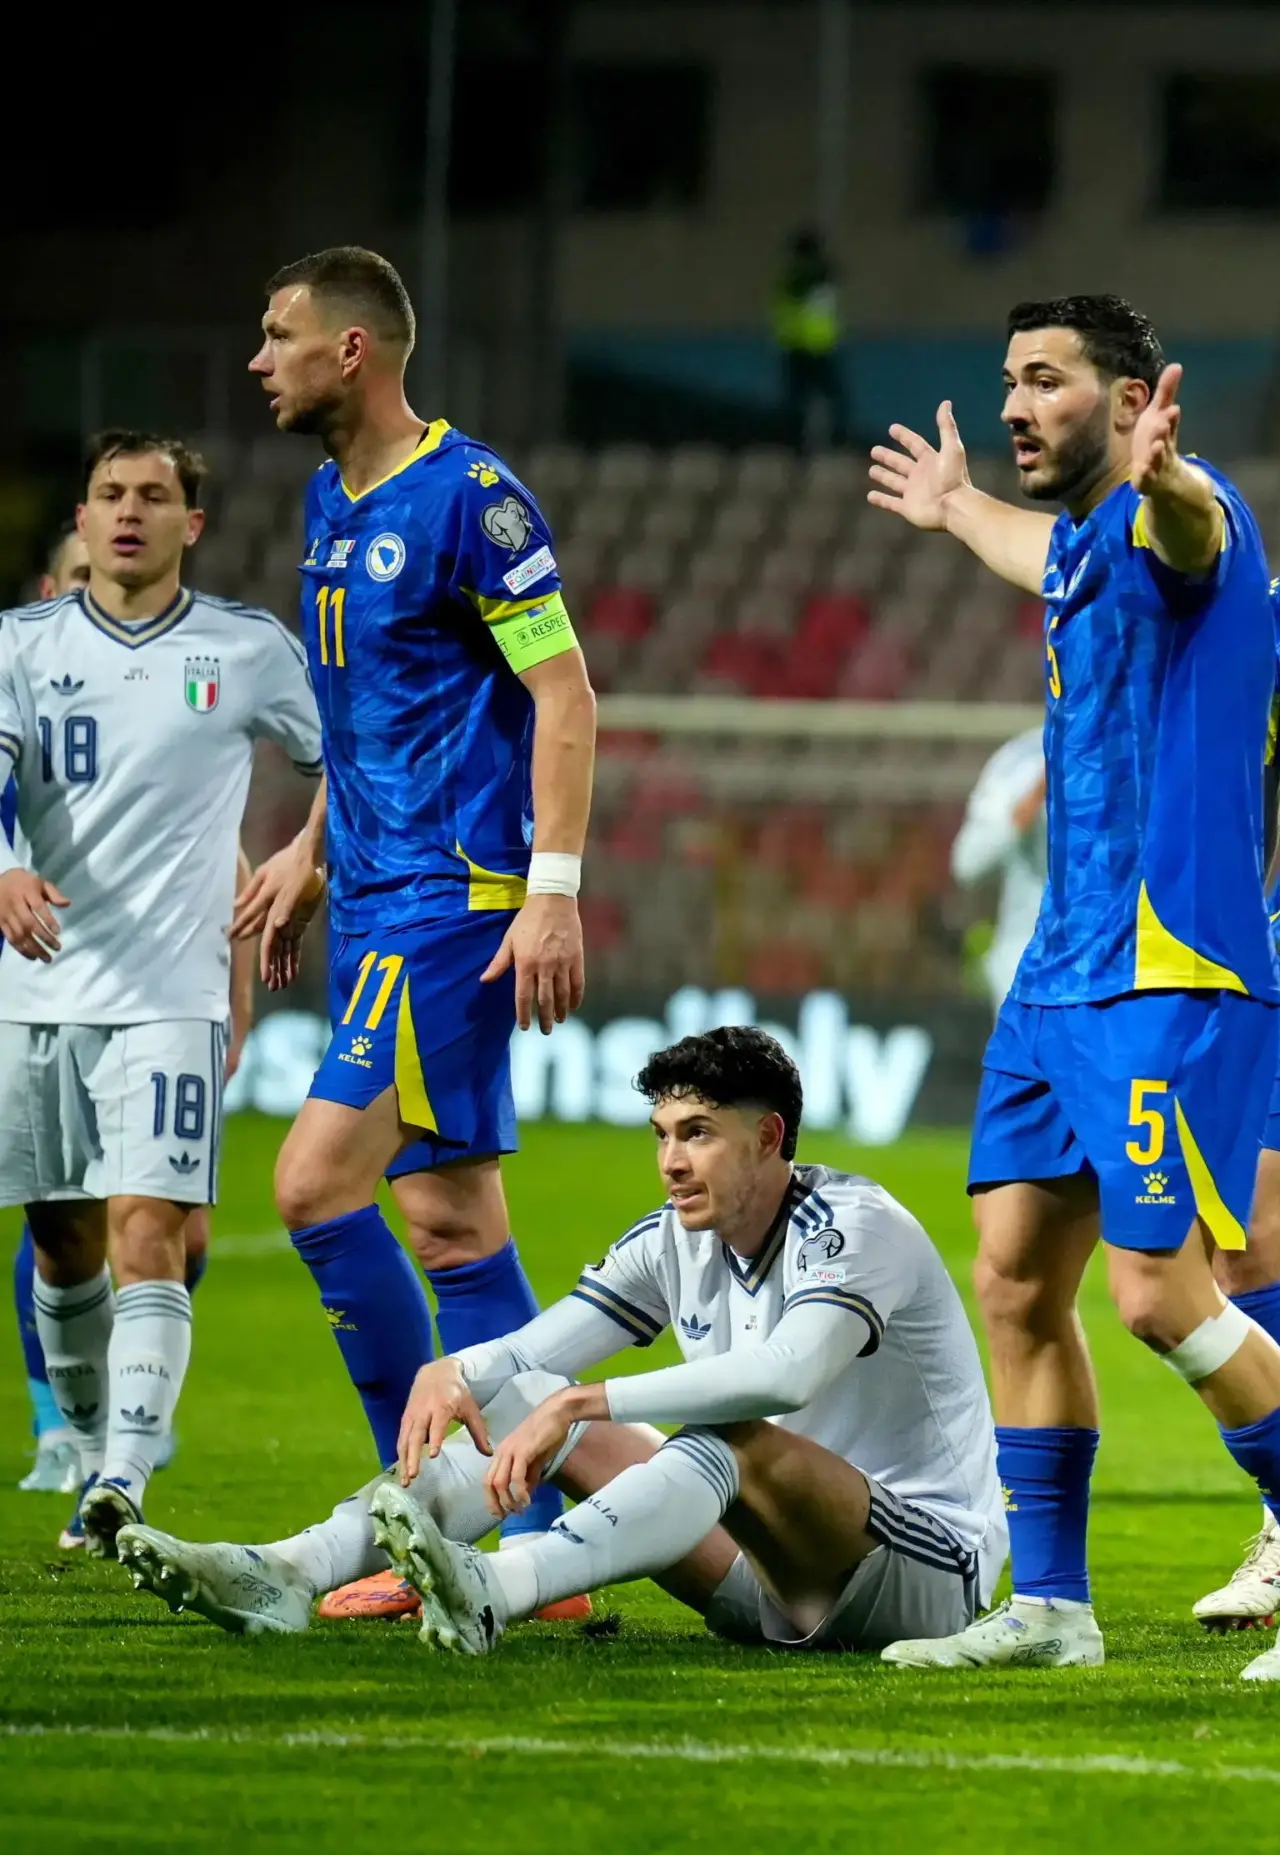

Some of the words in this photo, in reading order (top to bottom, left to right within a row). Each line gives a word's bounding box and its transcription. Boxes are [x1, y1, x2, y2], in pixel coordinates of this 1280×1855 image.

[316, 586, 346, 667] 11
[531, 614, 567, 637] RESPEC
[187, 667, 216, 677] ITALIA
[38, 716, 97, 784] 18
[341, 951, 404, 1031] 11
[338, 1053, 373, 1069] KELME
[151, 1071, 206, 1140] 18
[1126, 1078, 1168, 1166] 5
[1135, 1195, 1177, 1205] KELME
[47, 1363, 97, 1380] TALIA
[119, 1363, 171, 1383] ITALIA
